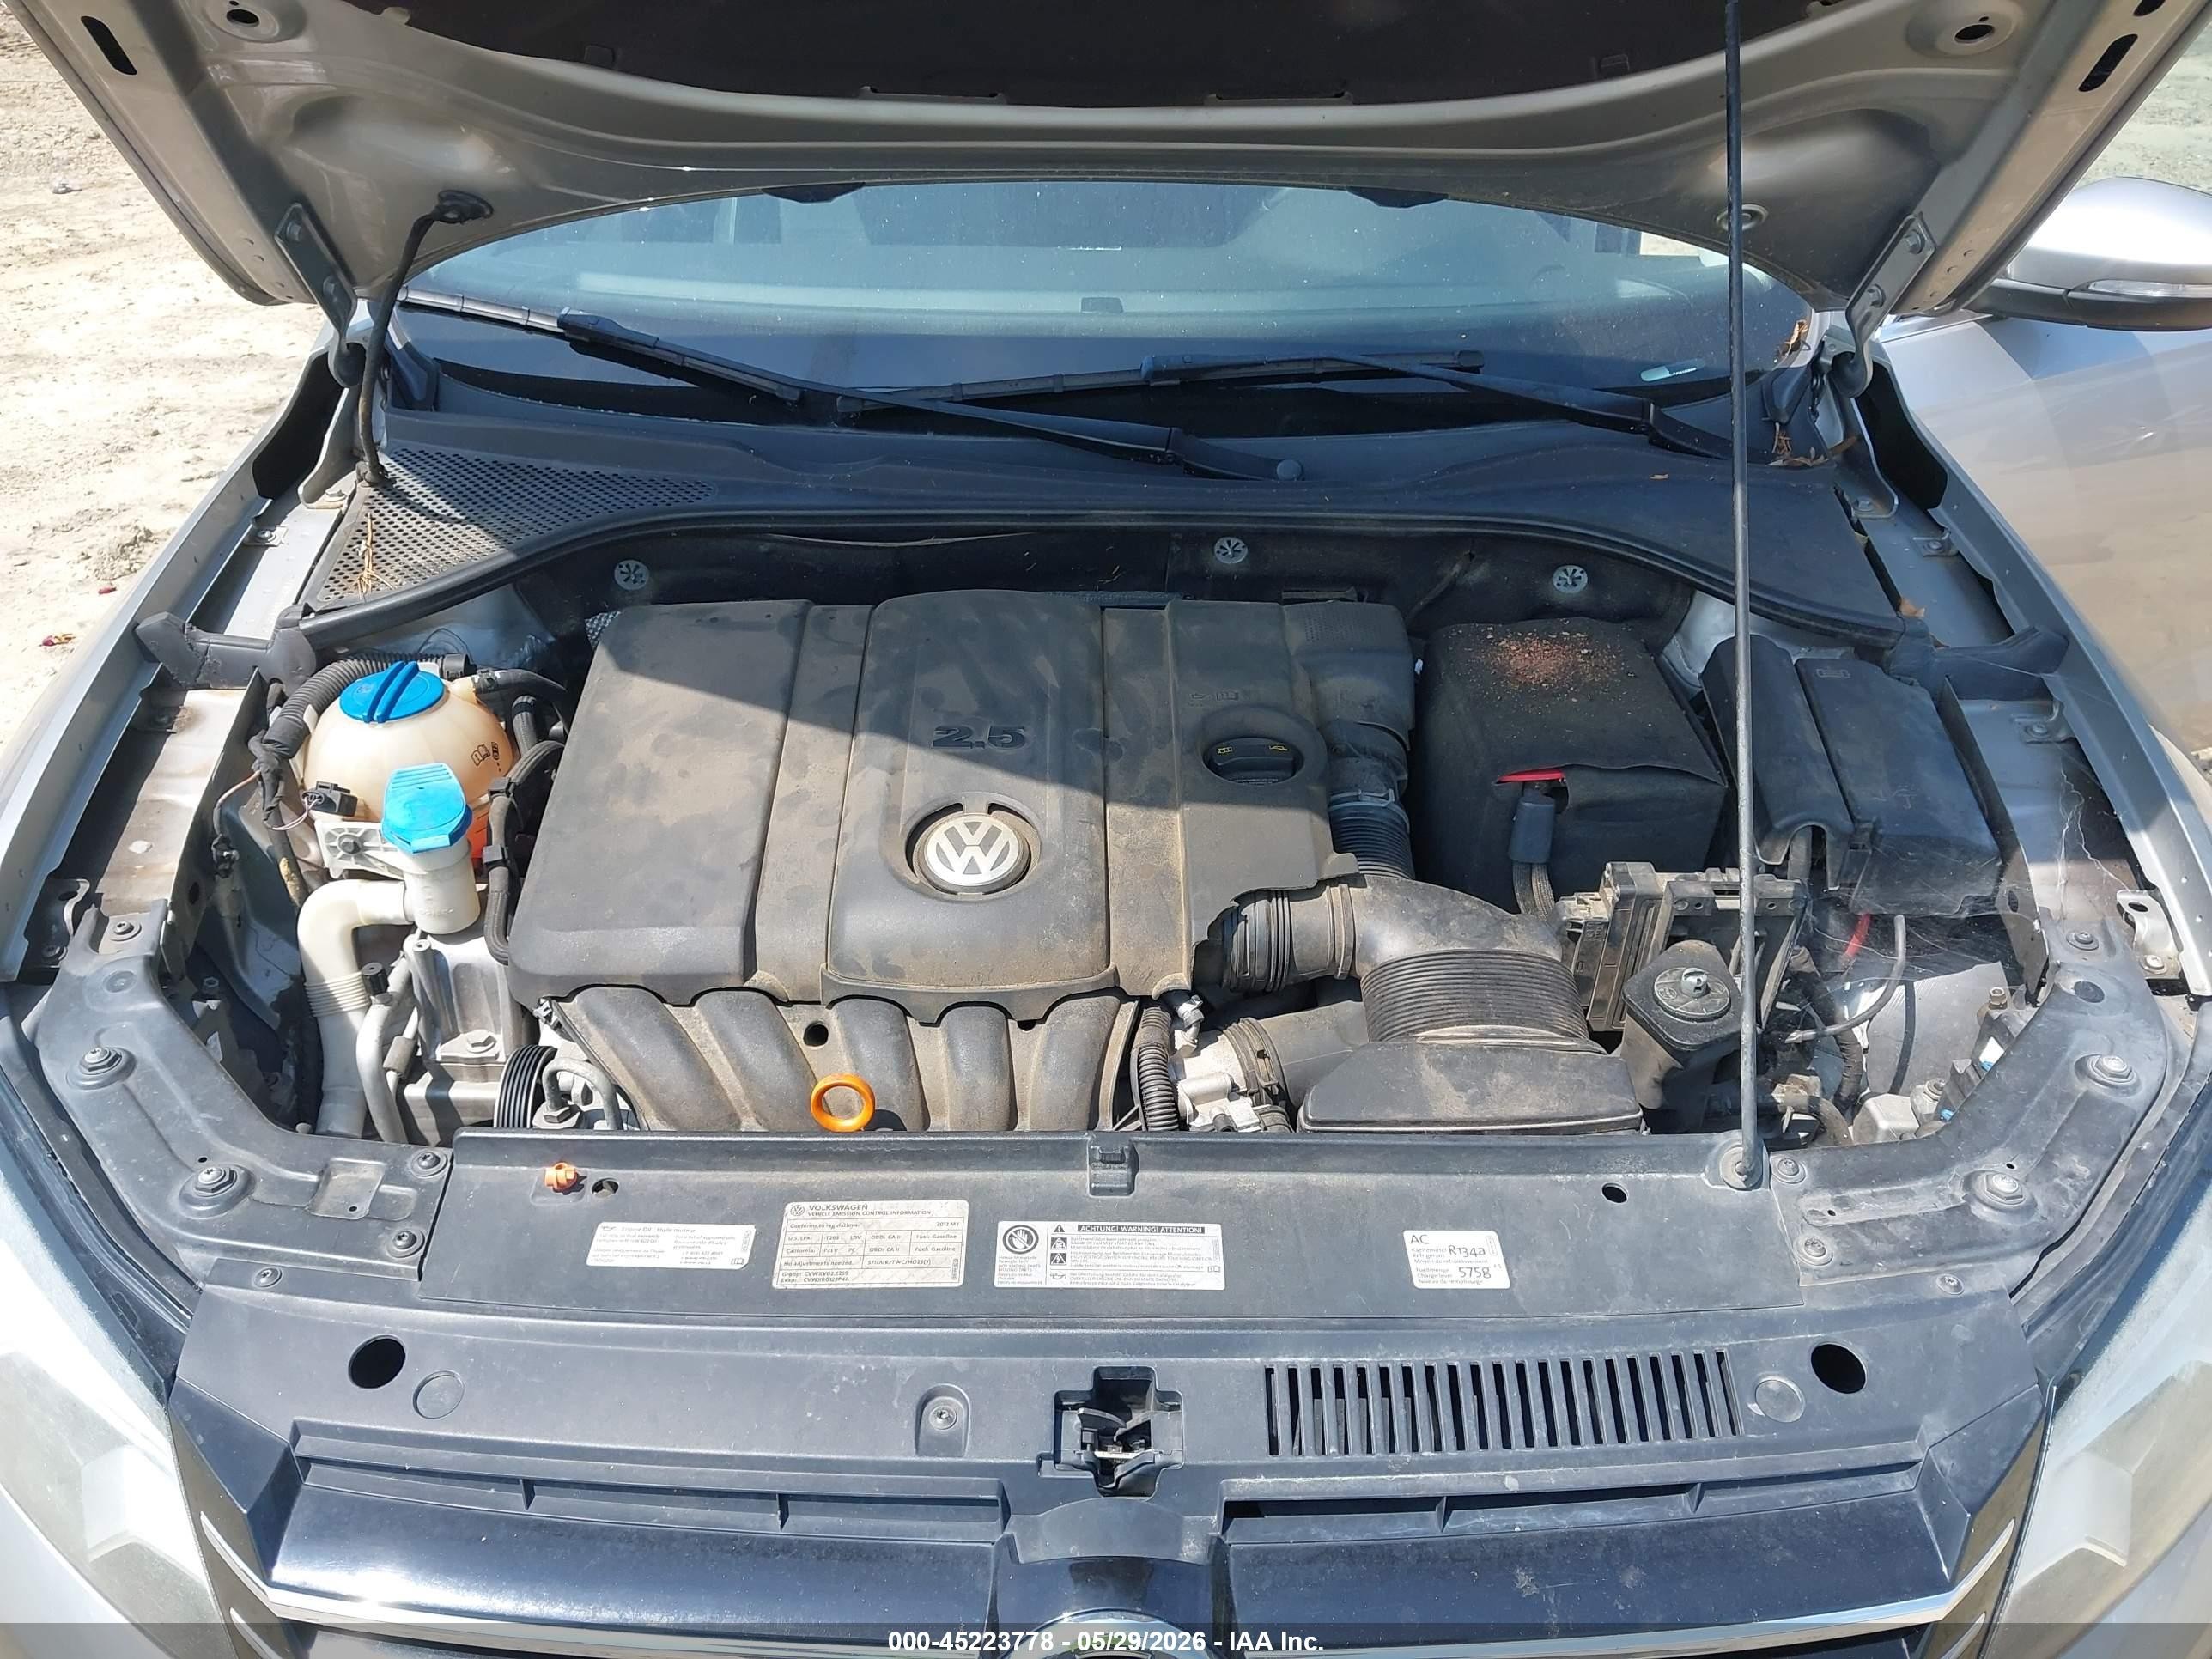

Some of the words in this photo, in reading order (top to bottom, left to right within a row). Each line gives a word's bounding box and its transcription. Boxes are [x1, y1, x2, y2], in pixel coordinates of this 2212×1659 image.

[933, 726, 1026, 749] 2.5
[1410, 1234, 1430, 1244] AC
[1448, 1244, 1486, 1257] R134a
[1458, 1267, 1492, 1279] 575g
